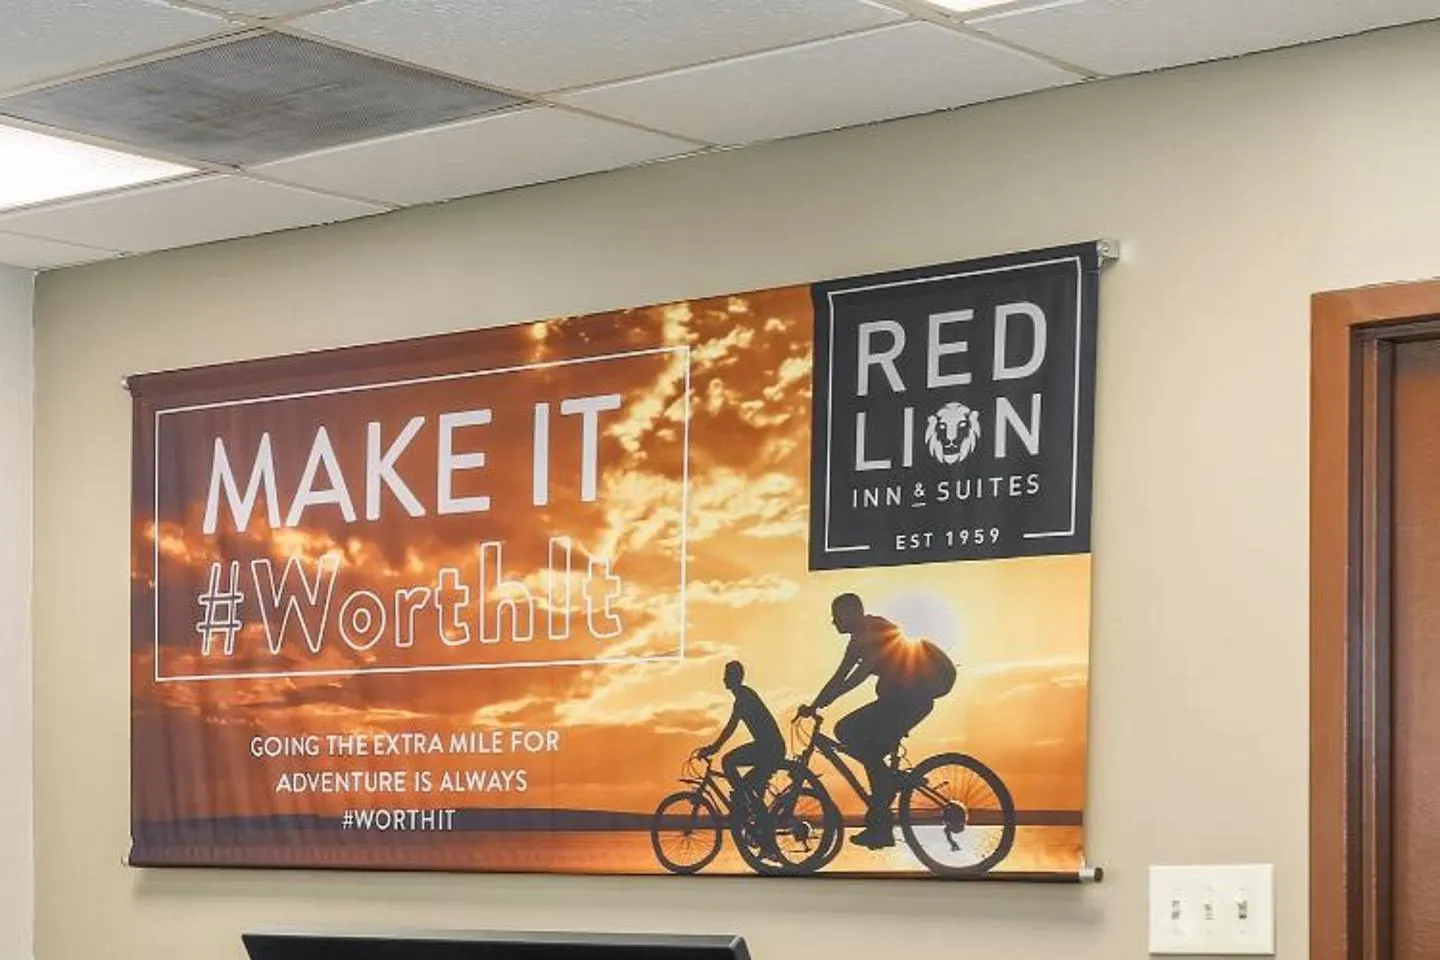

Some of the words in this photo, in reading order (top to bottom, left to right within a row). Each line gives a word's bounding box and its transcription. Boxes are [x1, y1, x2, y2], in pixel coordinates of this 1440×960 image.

[857, 302, 1047, 396] RED
[203, 408, 492, 534] MAKE
[530, 393, 621, 506] IT
[852, 485, 902, 508] INN
[912, 481, 927, 507] &
[936, 473, 1040, 501] SUITES
[895, 532, 934, 550] EST
[945, 527, 1000, 547] 1959
[196, 536, 622, 656] #WorthIt
[250, 734, 320, 758] GOING
[326, 733, 368, 757] THE
[374, 731, 444, 756] EXTRA
[449, 732, 504, 754] MILE
[511, 730, 560, 752] FOR
[276, 770, 406, 794] ADVENTURE
[414, 769, 433, 793] IS
[439, 768, 528, 793] ALWAYS
[342, 809, 457, 832] #WORTHIT
